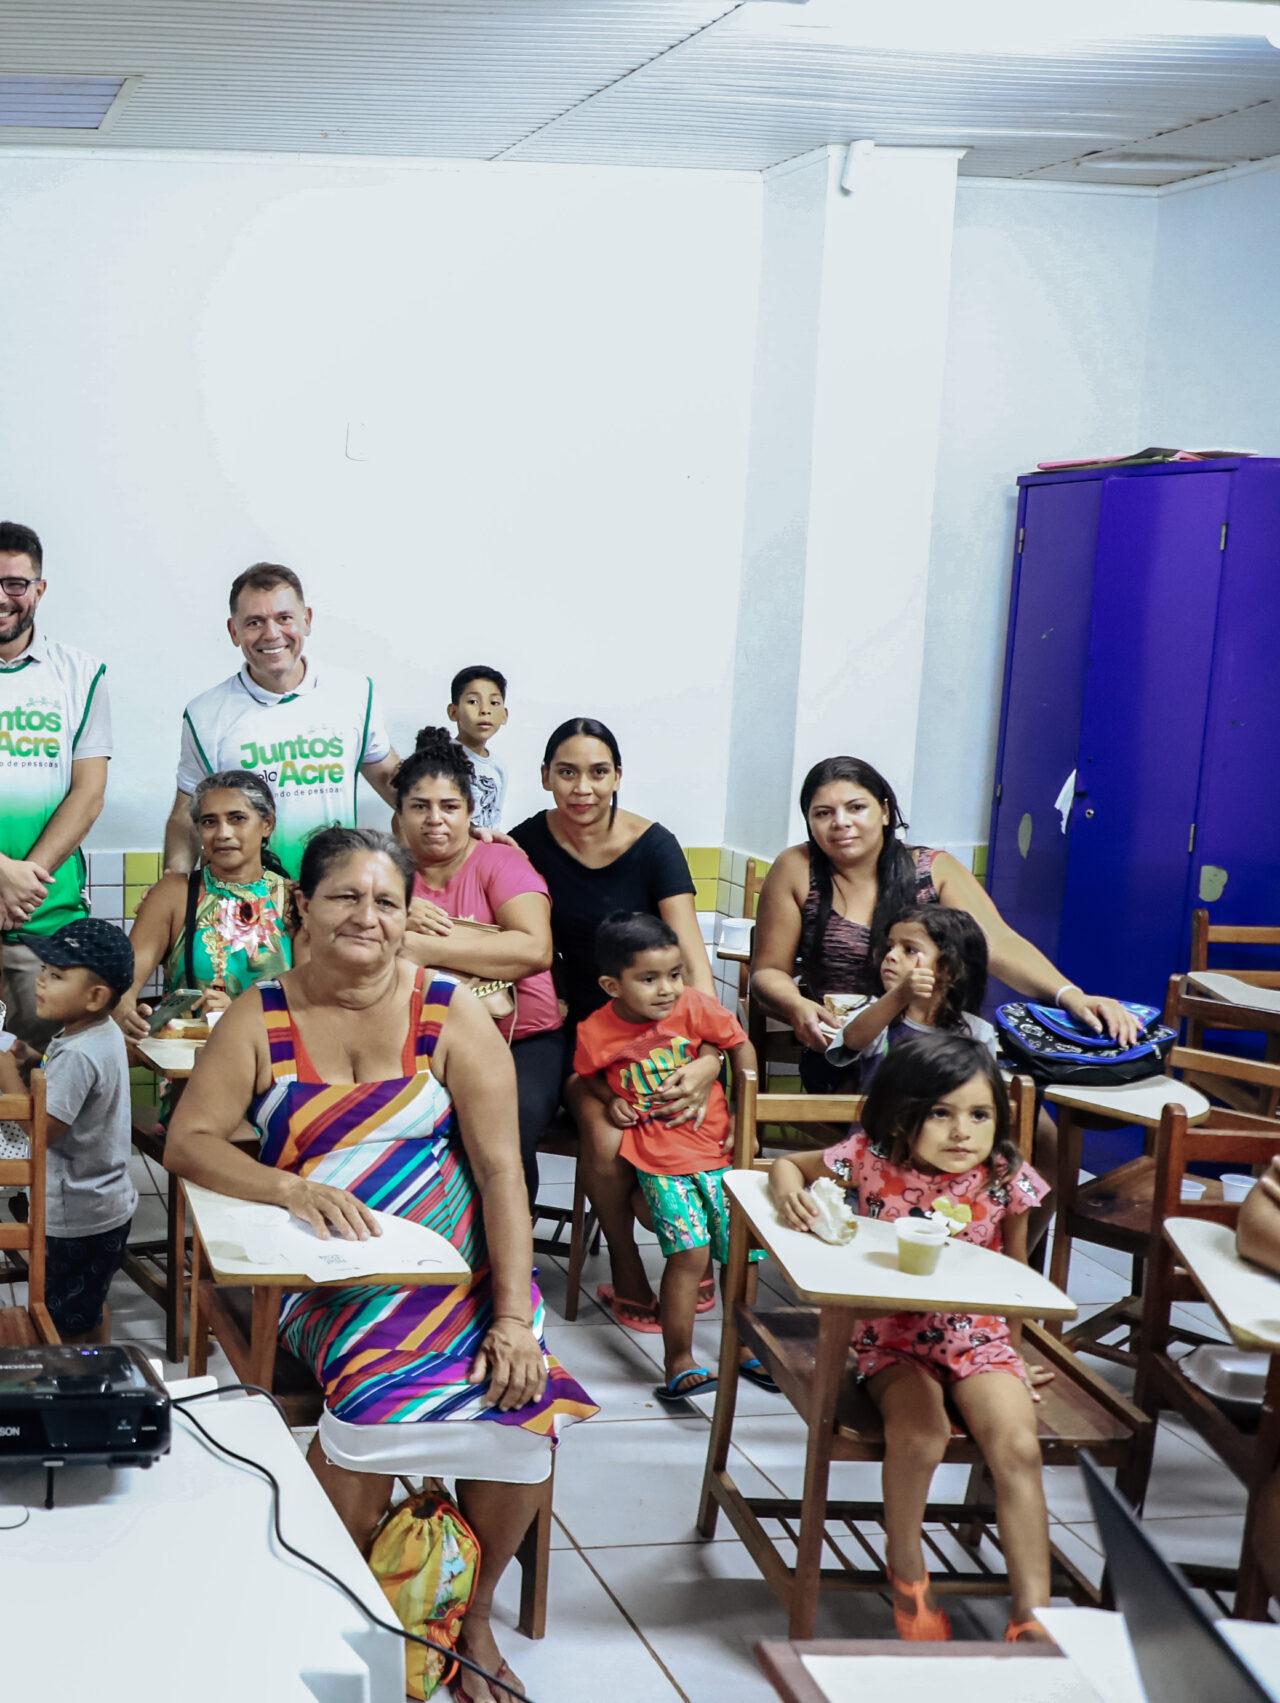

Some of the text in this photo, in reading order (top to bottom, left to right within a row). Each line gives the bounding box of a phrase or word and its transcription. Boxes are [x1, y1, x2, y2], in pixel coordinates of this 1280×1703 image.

[7, 760, 18, 768] de
[240, 734, 344, 769] Juntos
[278, 761, 344, 787] Acre
